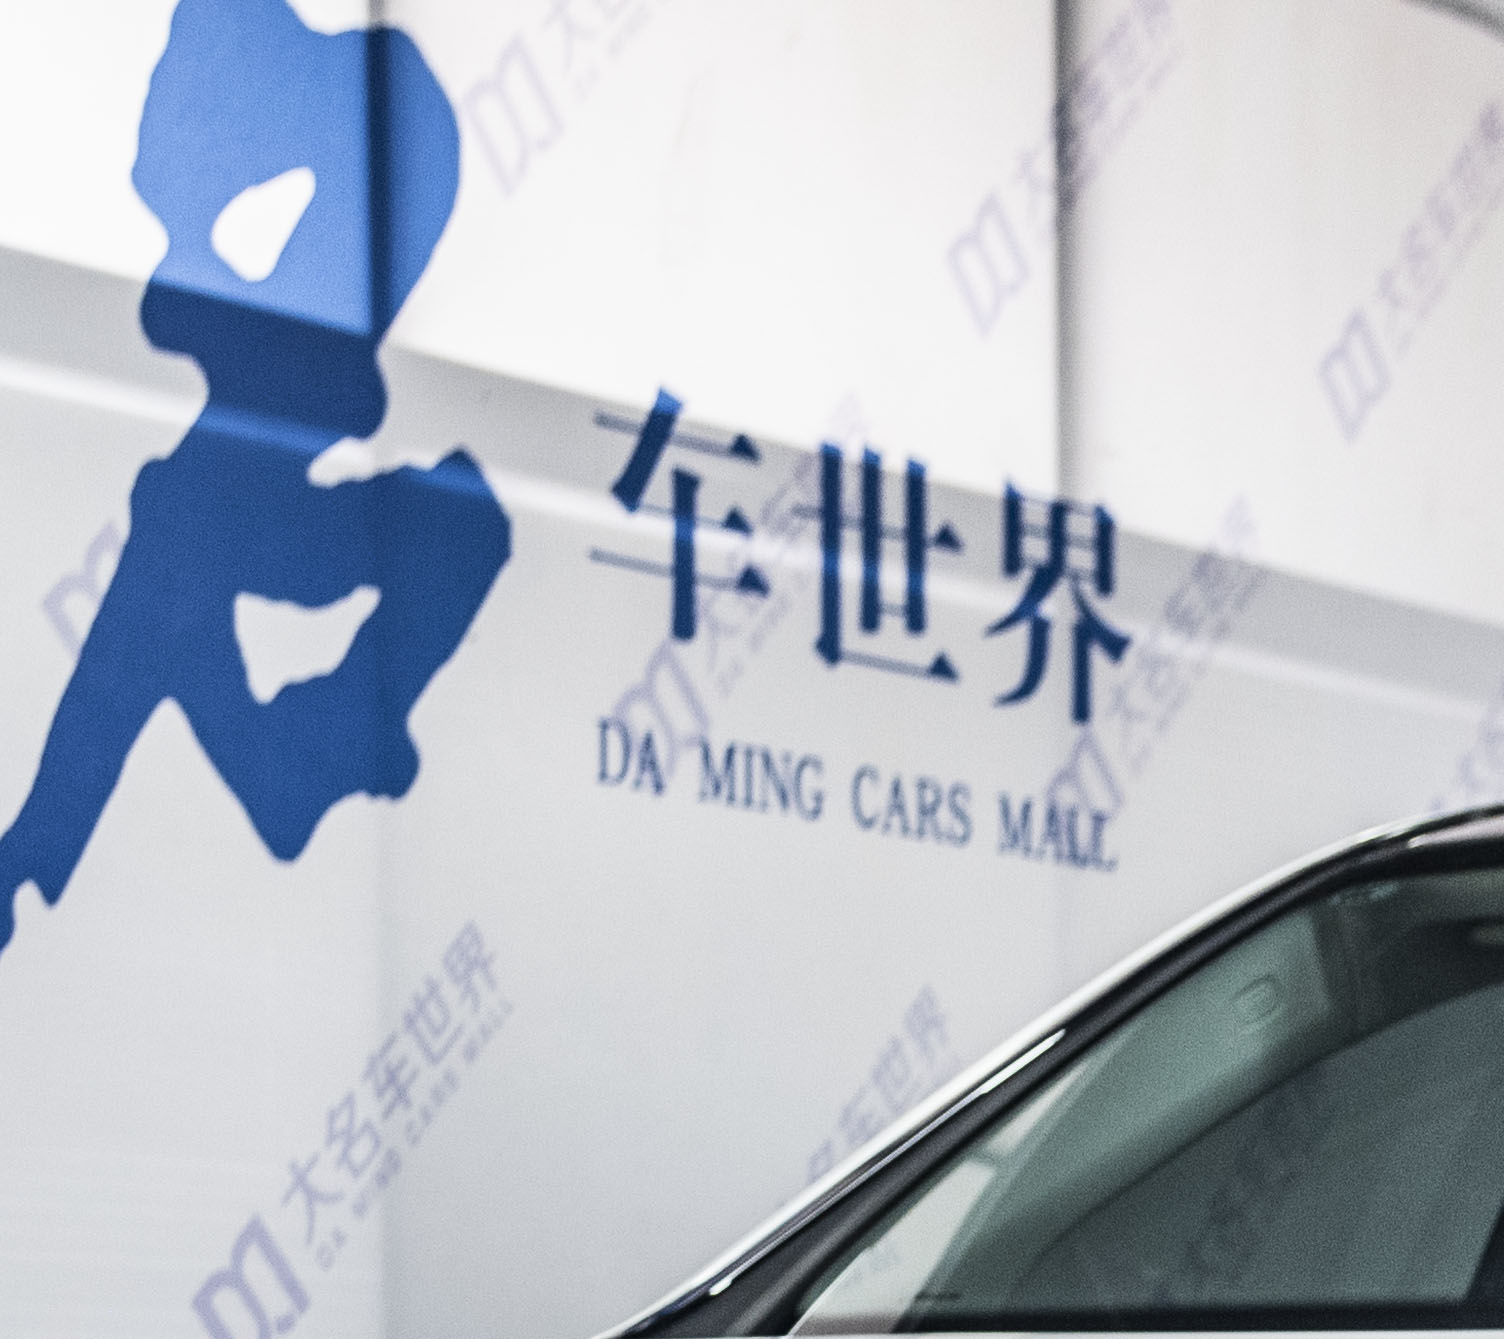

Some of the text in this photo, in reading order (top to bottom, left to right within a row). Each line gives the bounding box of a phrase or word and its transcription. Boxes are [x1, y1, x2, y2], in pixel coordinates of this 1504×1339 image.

[589, 386, 1132, 726] 车世界
[596, 717, 1119, 873] DA MING CARS MALL
